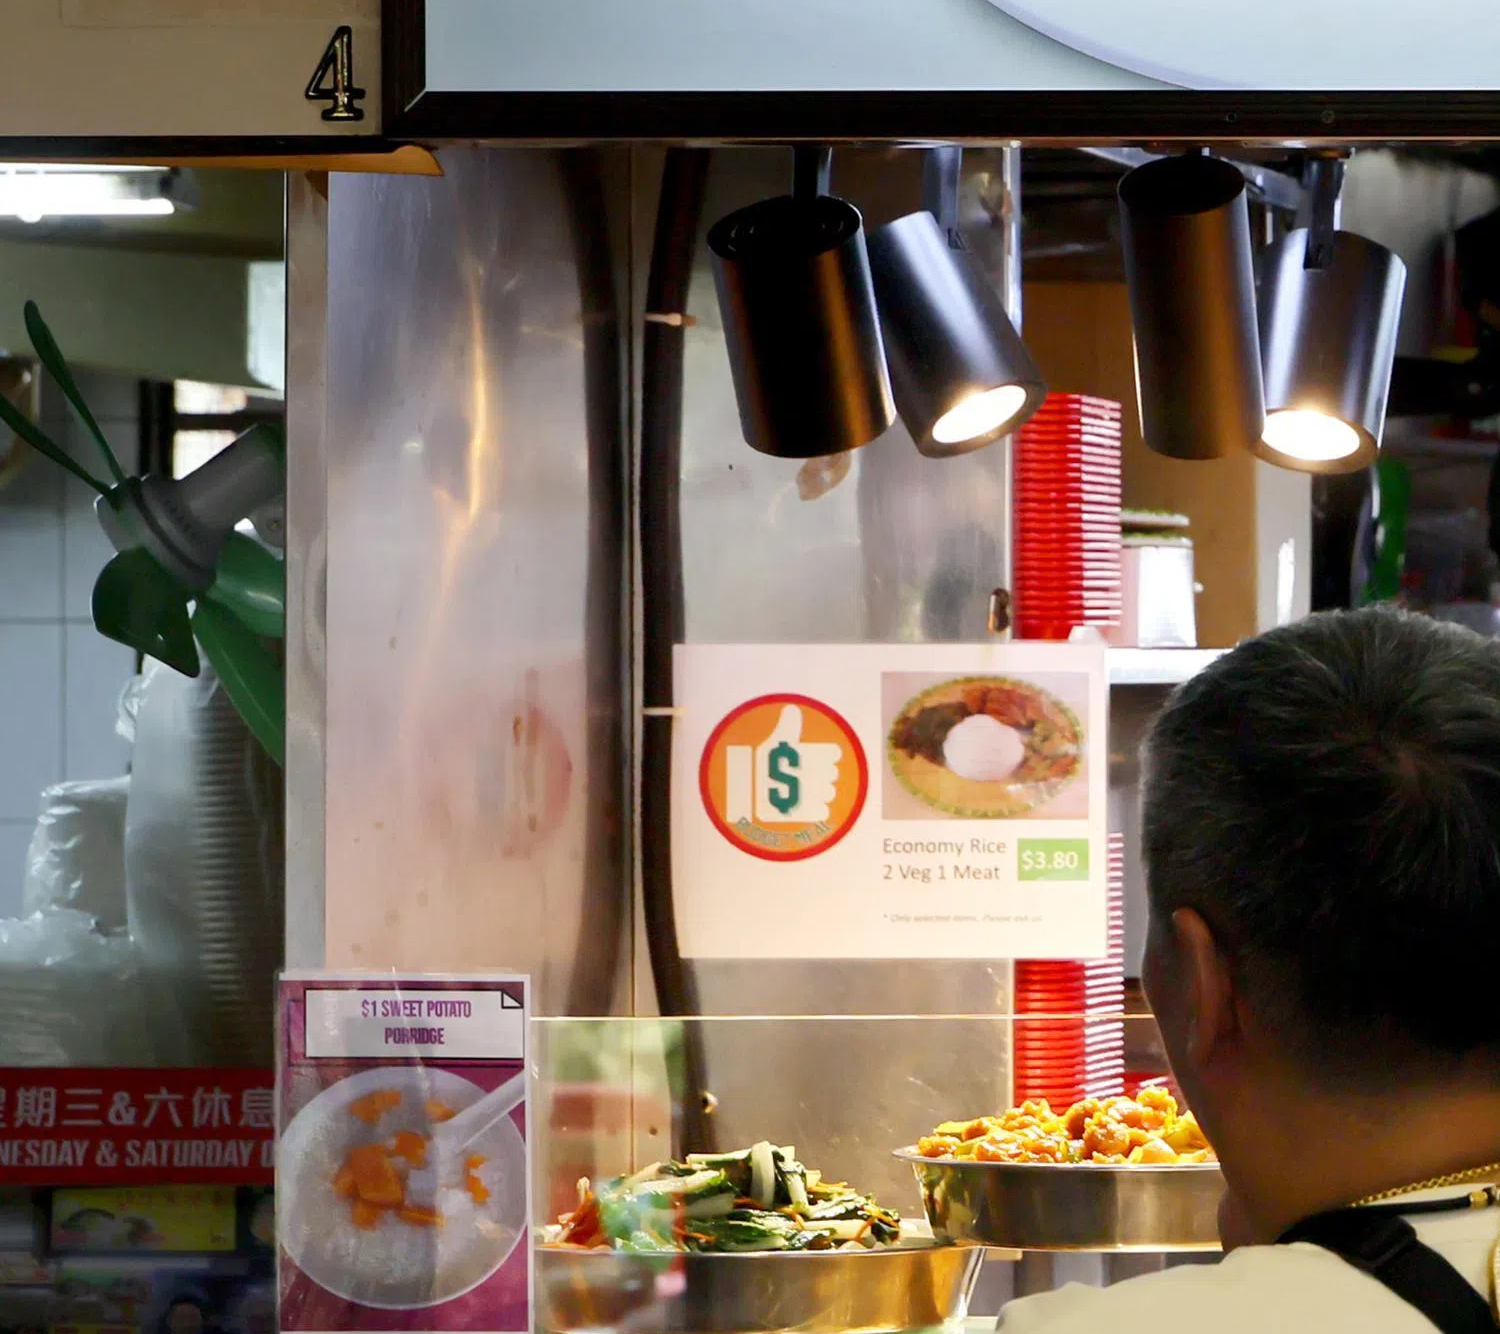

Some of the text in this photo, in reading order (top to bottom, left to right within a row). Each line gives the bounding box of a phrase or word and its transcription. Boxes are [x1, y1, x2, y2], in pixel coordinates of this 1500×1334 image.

[305, 26, 366, 121] 4
[883, 837, 1006, 857] Economy Rice
[1022, 850, 1079, 871] $3.80
[883, 865, 1000, 883] 2 Veg 1 Meat
[361, 999, 472, 1018] $1 SWEET POTATO
[384, 1027, 445, 1045] PORRIDGE
[0, 1086, 275, 1128] 期三&六休息
[96, 1139, 119, 1167] &
[125, 1139, 255, 1167] SATURDAY
